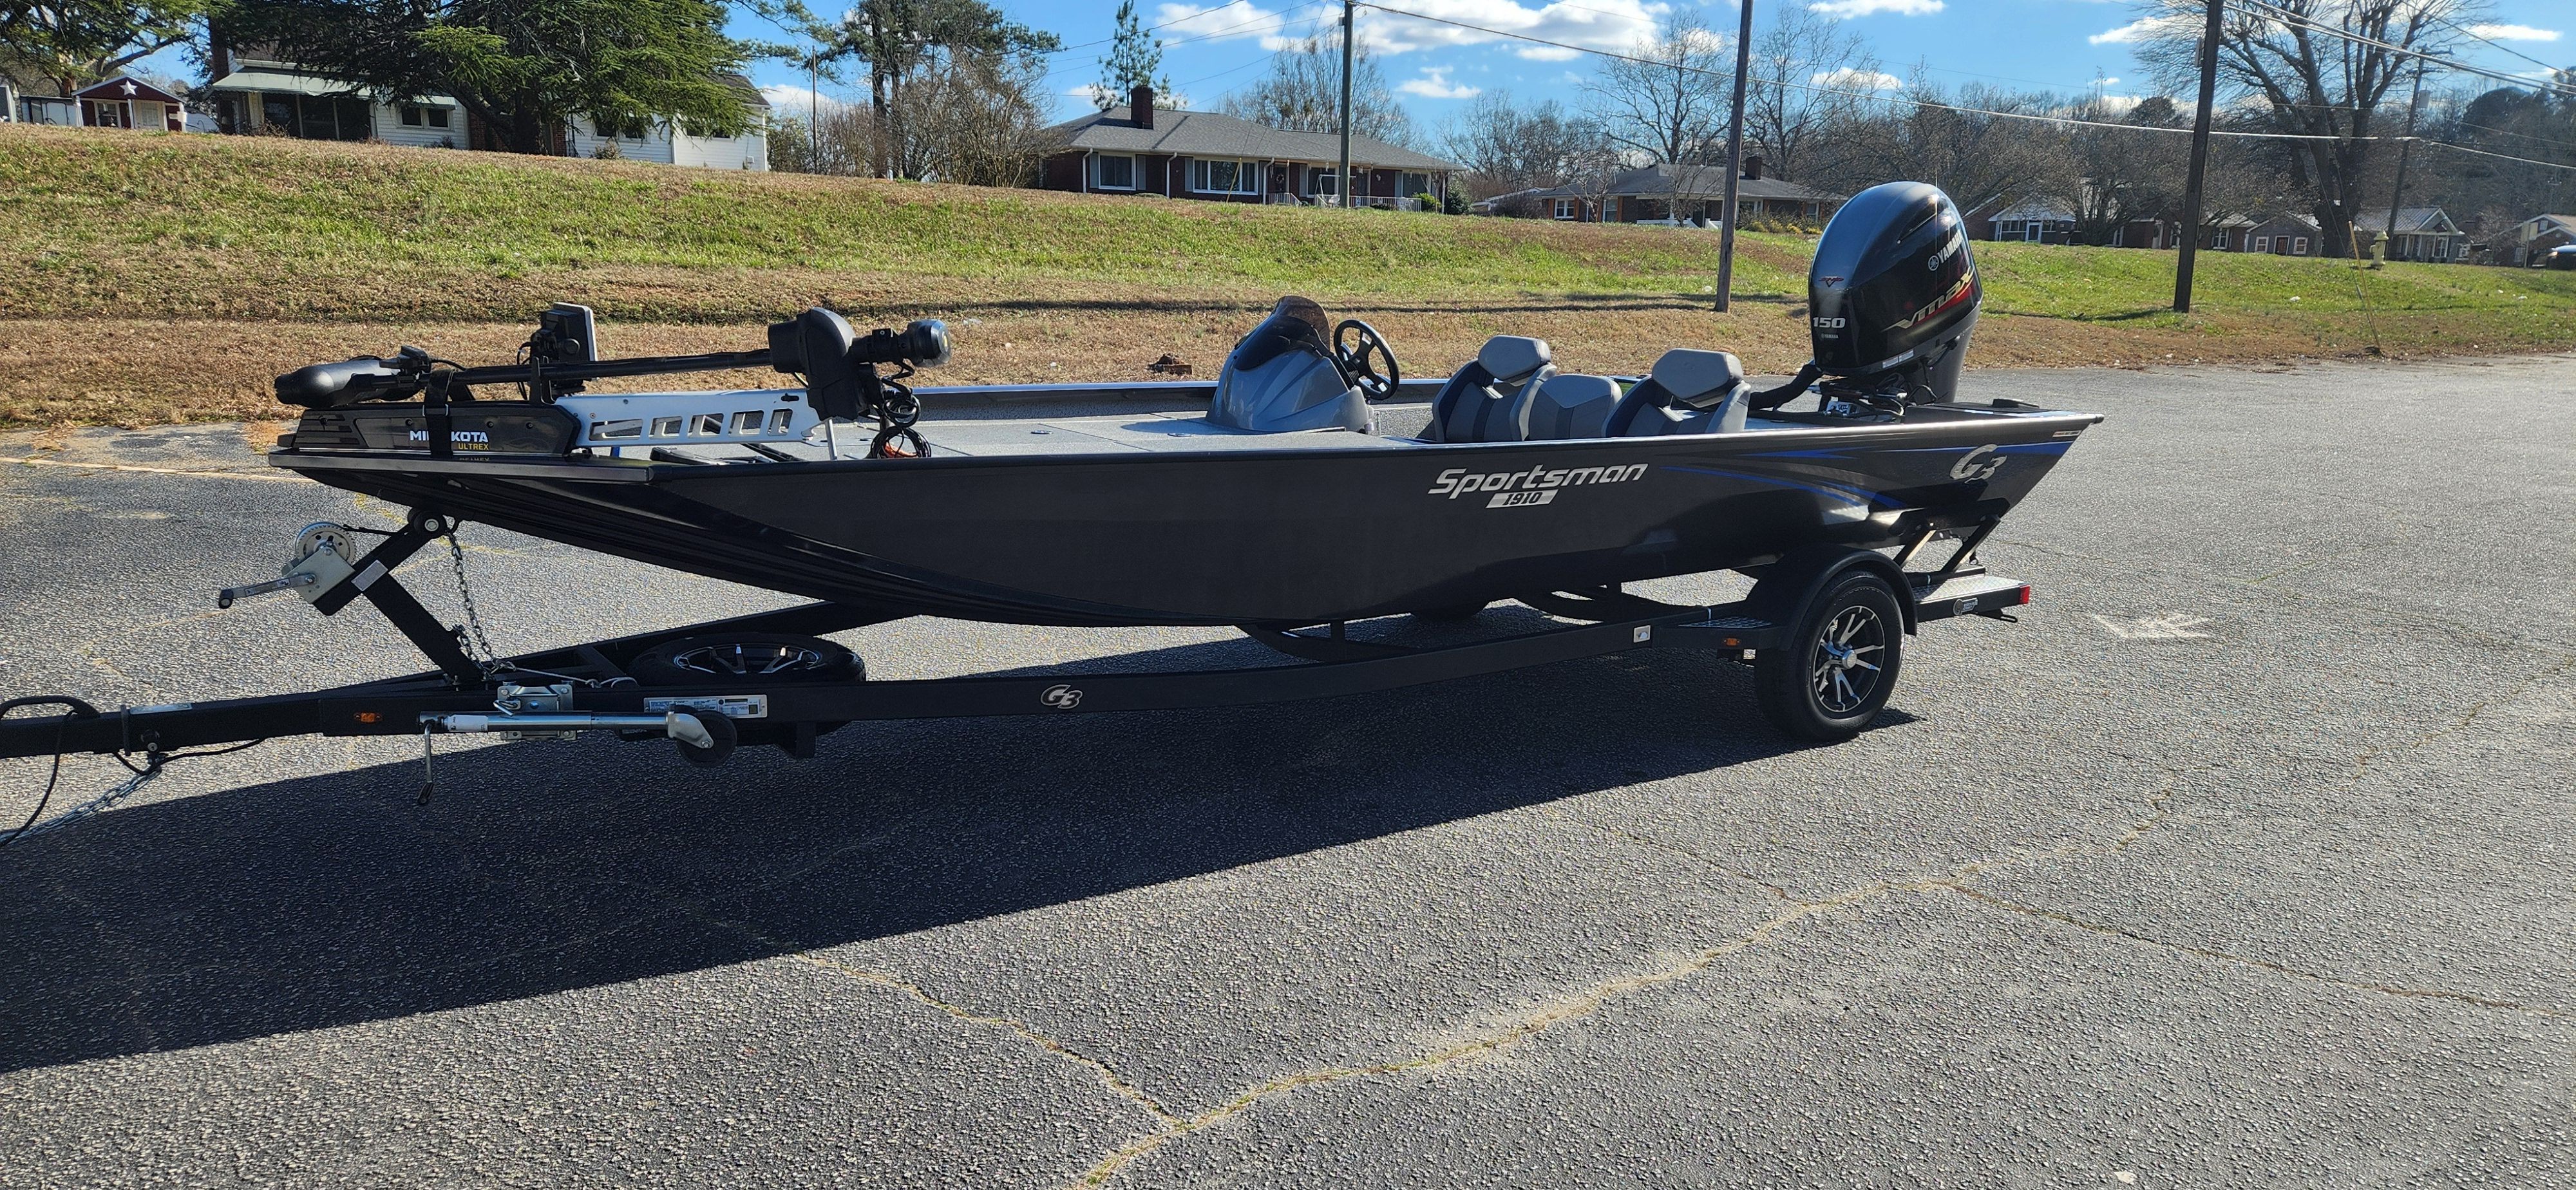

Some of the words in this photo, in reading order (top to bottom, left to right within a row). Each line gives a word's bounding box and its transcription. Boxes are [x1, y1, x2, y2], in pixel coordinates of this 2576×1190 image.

[1812, 317, 1846, 328] 150
[451, 431, 489, 442] KOTA
[1949, 443, 2007, 484] G3
[1427, 462, 1649, 500] Sportsman
[1502, 491, 1544, 506] 1910
[1040, 684, 1083, 710] G3
